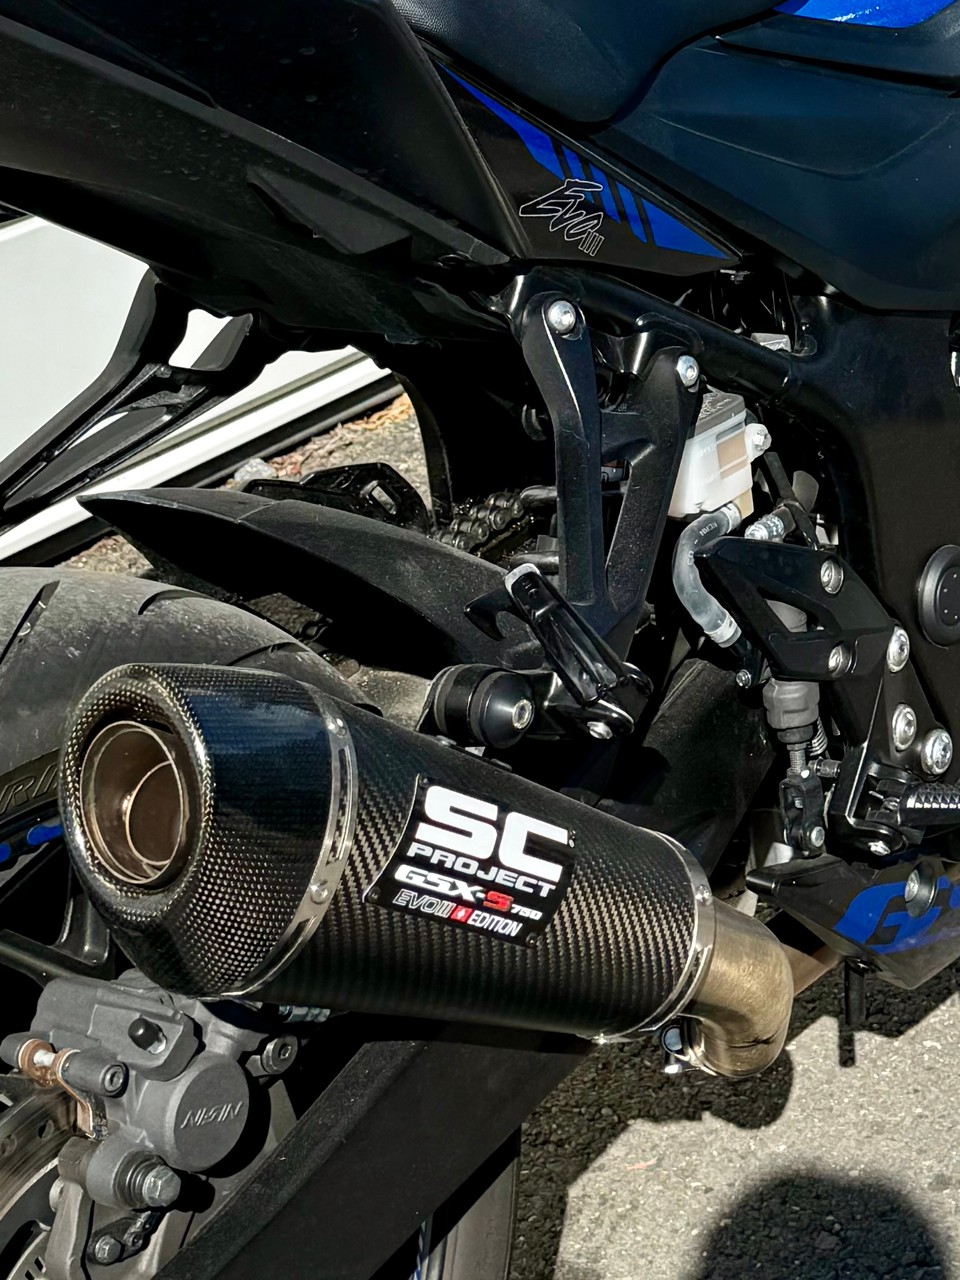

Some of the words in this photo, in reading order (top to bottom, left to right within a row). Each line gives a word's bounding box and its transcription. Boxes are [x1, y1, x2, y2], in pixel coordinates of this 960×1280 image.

[415, 785, 568, 883] SC
[406, 841, 556, 898] PROJECT
[467, 910, 524, 937] EDITION
[511, 904, 543, 921] 750
